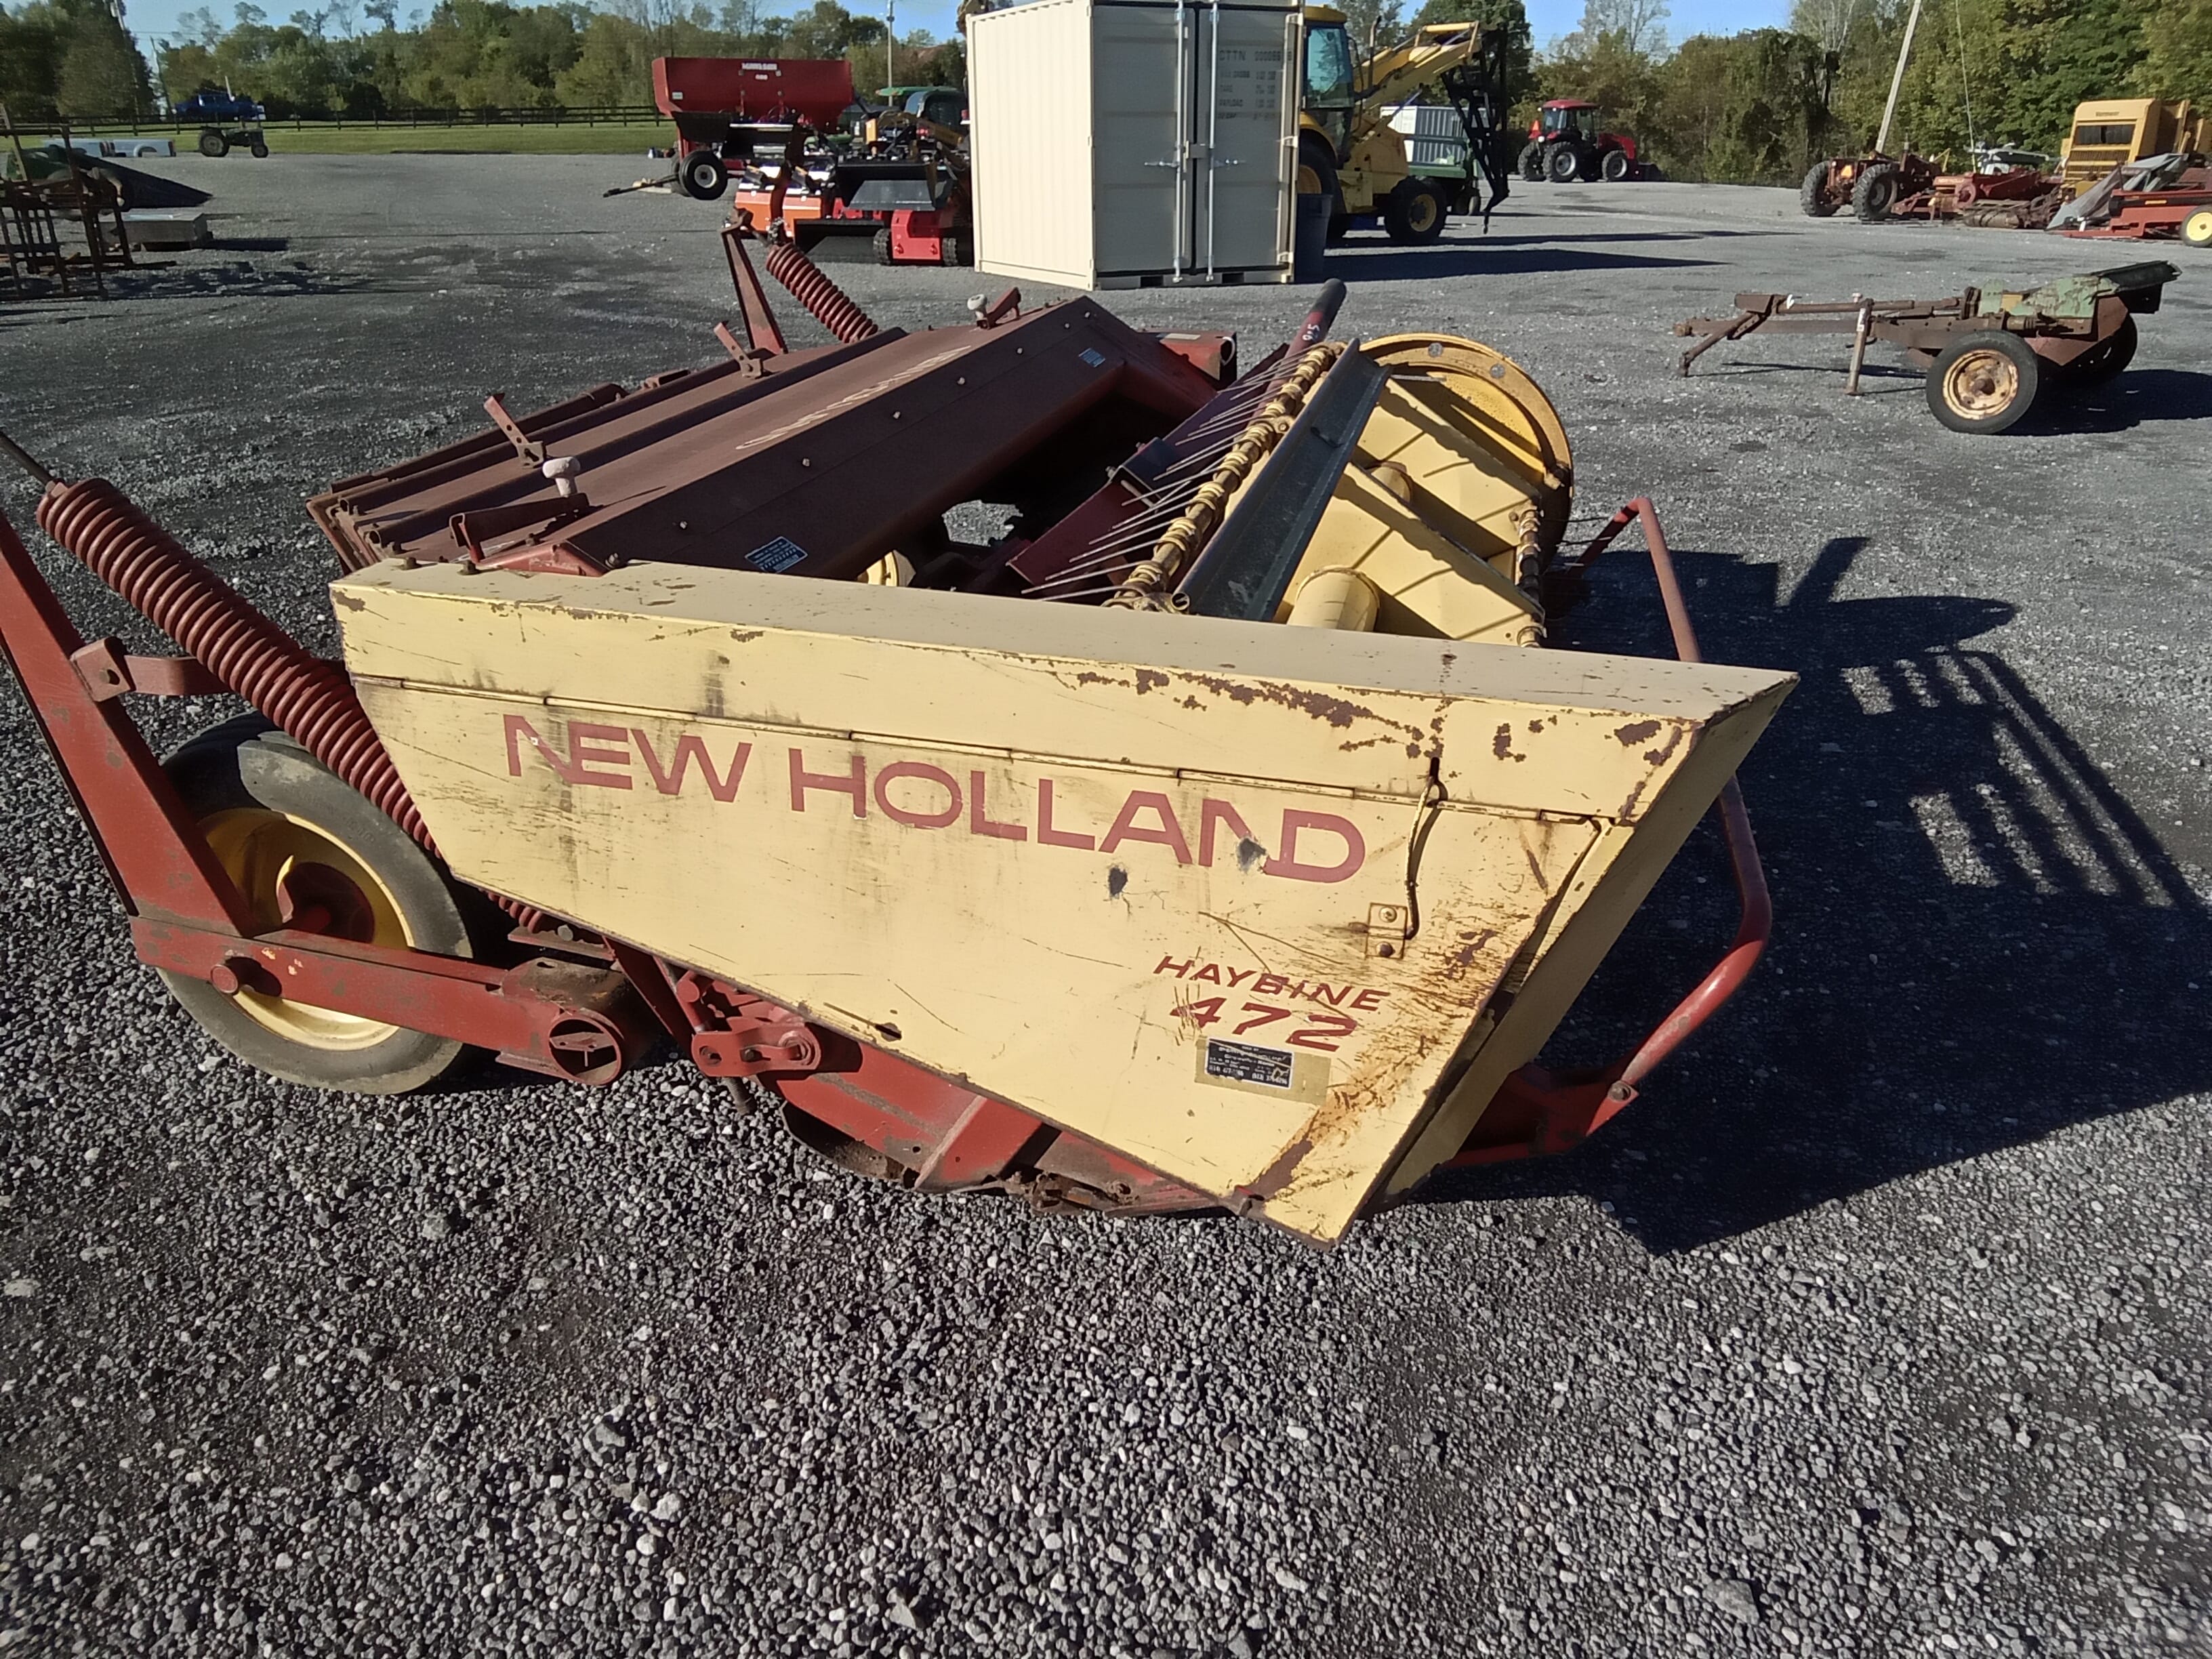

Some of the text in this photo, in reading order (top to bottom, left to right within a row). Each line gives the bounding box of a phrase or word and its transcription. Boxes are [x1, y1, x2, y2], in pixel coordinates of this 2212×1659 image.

[503, 714, 1366, 884] NEW HOLLAND
[1153, 956, 1391, 1012] HAYBINE
[1170, 997, 1358, 1052] 472
